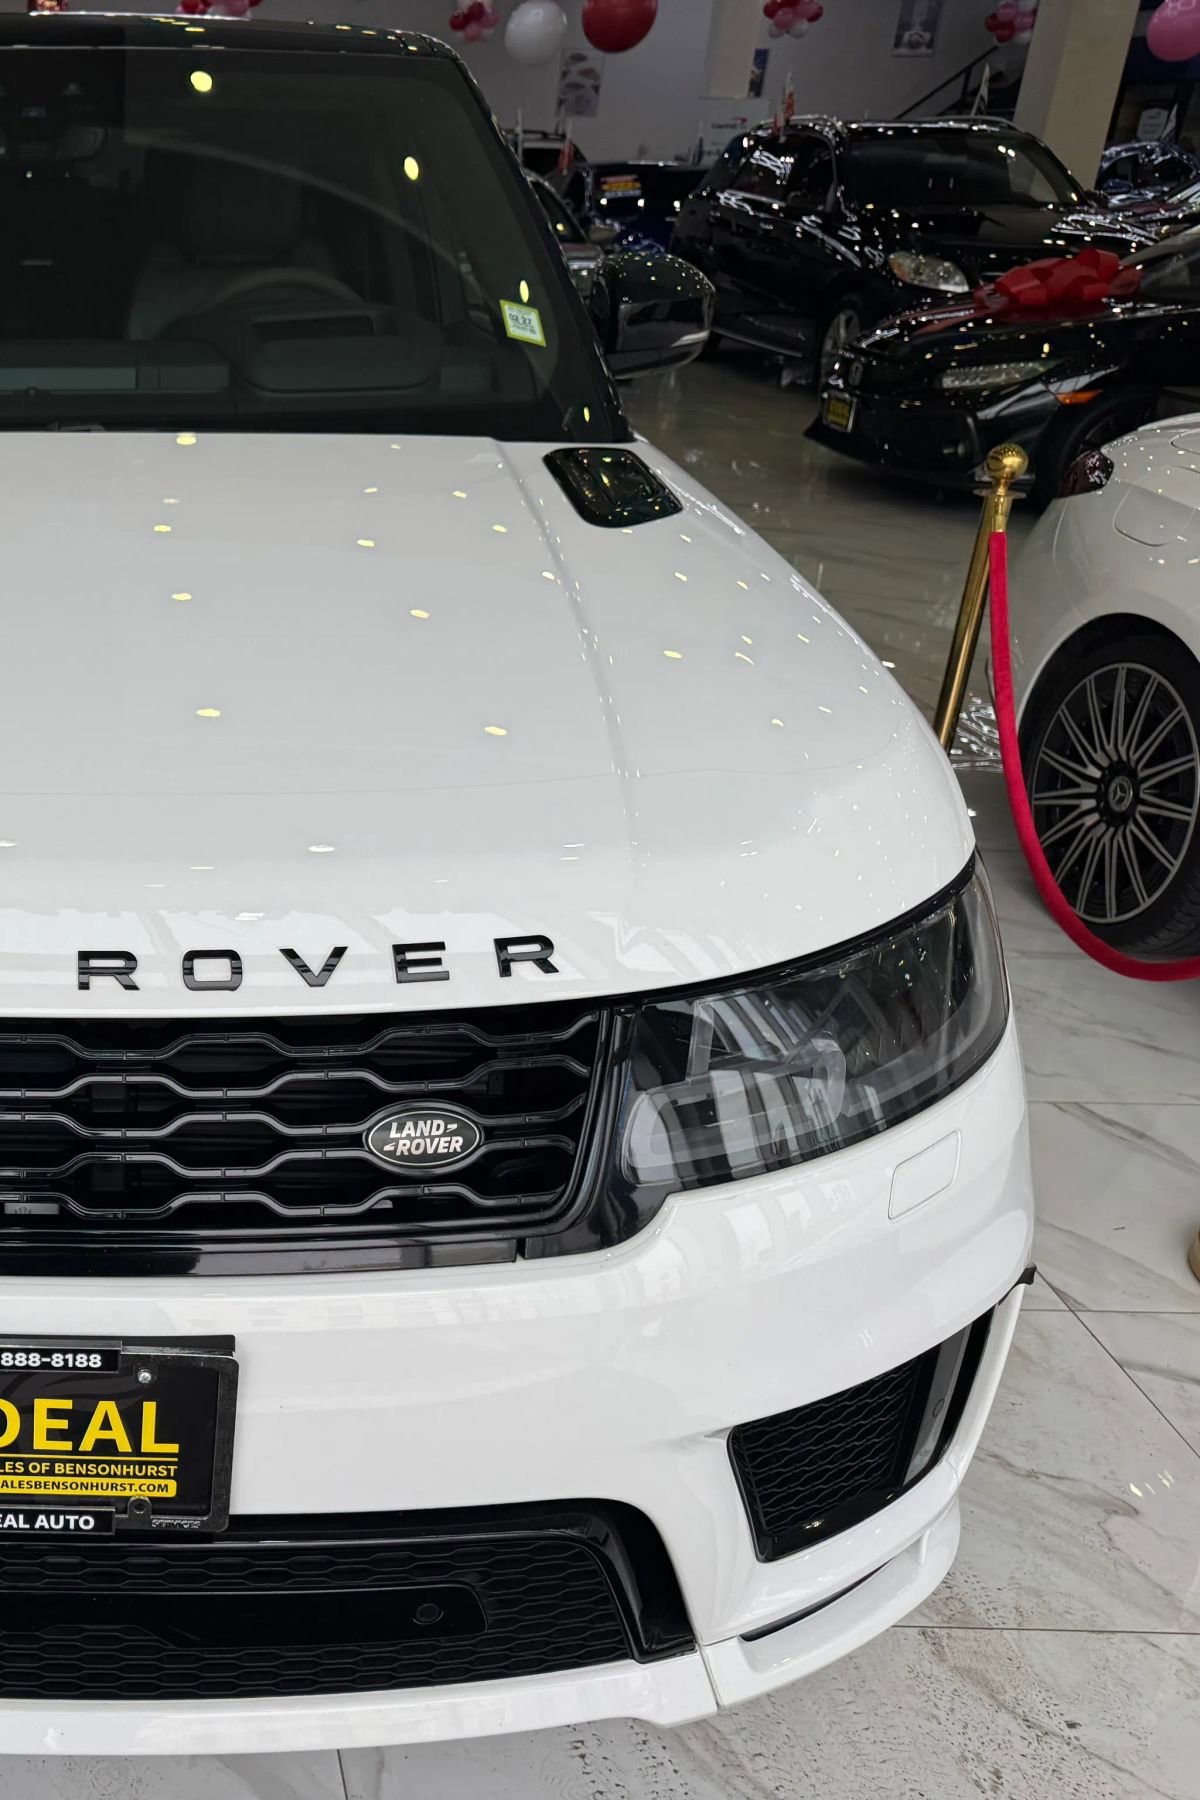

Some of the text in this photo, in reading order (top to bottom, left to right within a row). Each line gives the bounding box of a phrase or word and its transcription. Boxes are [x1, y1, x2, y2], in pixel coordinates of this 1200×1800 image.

[78, 934, 560, 991] ROVER
[389, 1119, 445, 1138] LAND
[395, 1136, 464, 1156] ROVER
[0, 1352, 102, 1368] 888-8188
[28, 1462, 50, 1475] OF
[54, 1463, 178, 1477] BENSONHURST
[35, 1515, 95, 1530] AUTO
